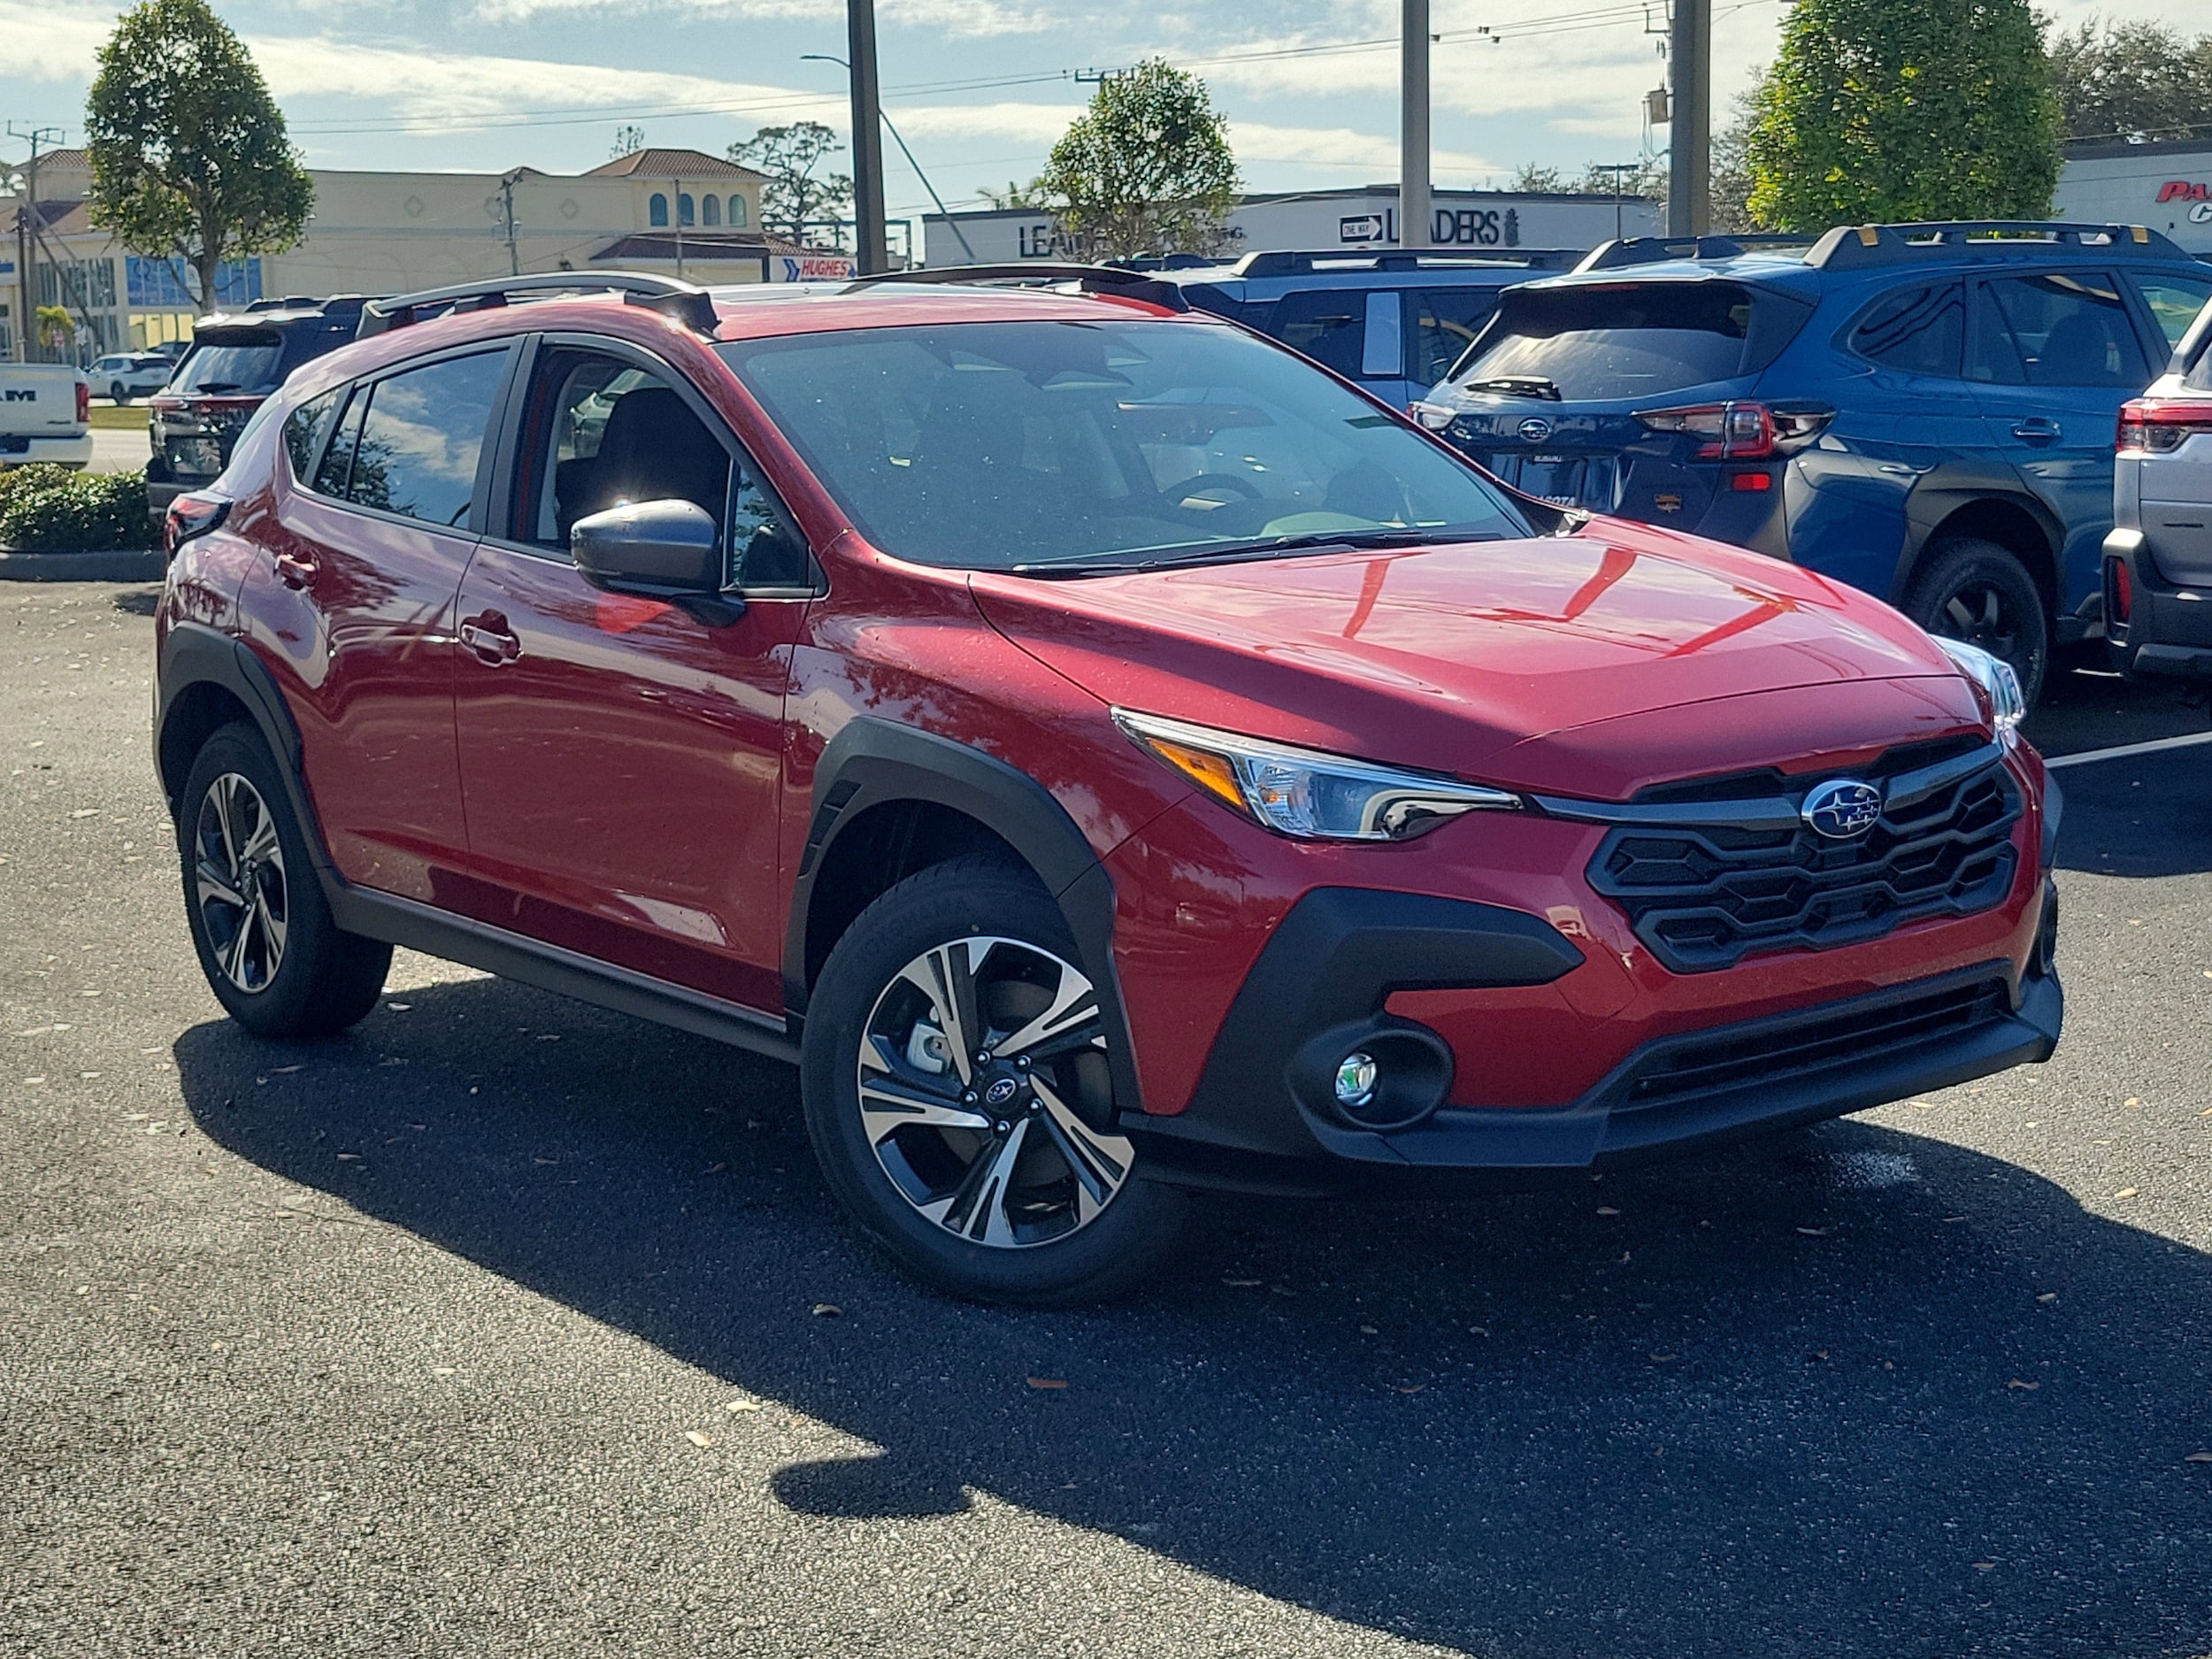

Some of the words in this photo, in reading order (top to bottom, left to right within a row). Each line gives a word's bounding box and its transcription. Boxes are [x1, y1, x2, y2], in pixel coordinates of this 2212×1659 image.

[2154, 180, 2212, 203] PA
[1386, 207, 1500, 245] LDERS
[801, 258, 848, 276] HUGHES
[0, 390, 36, 401] M
